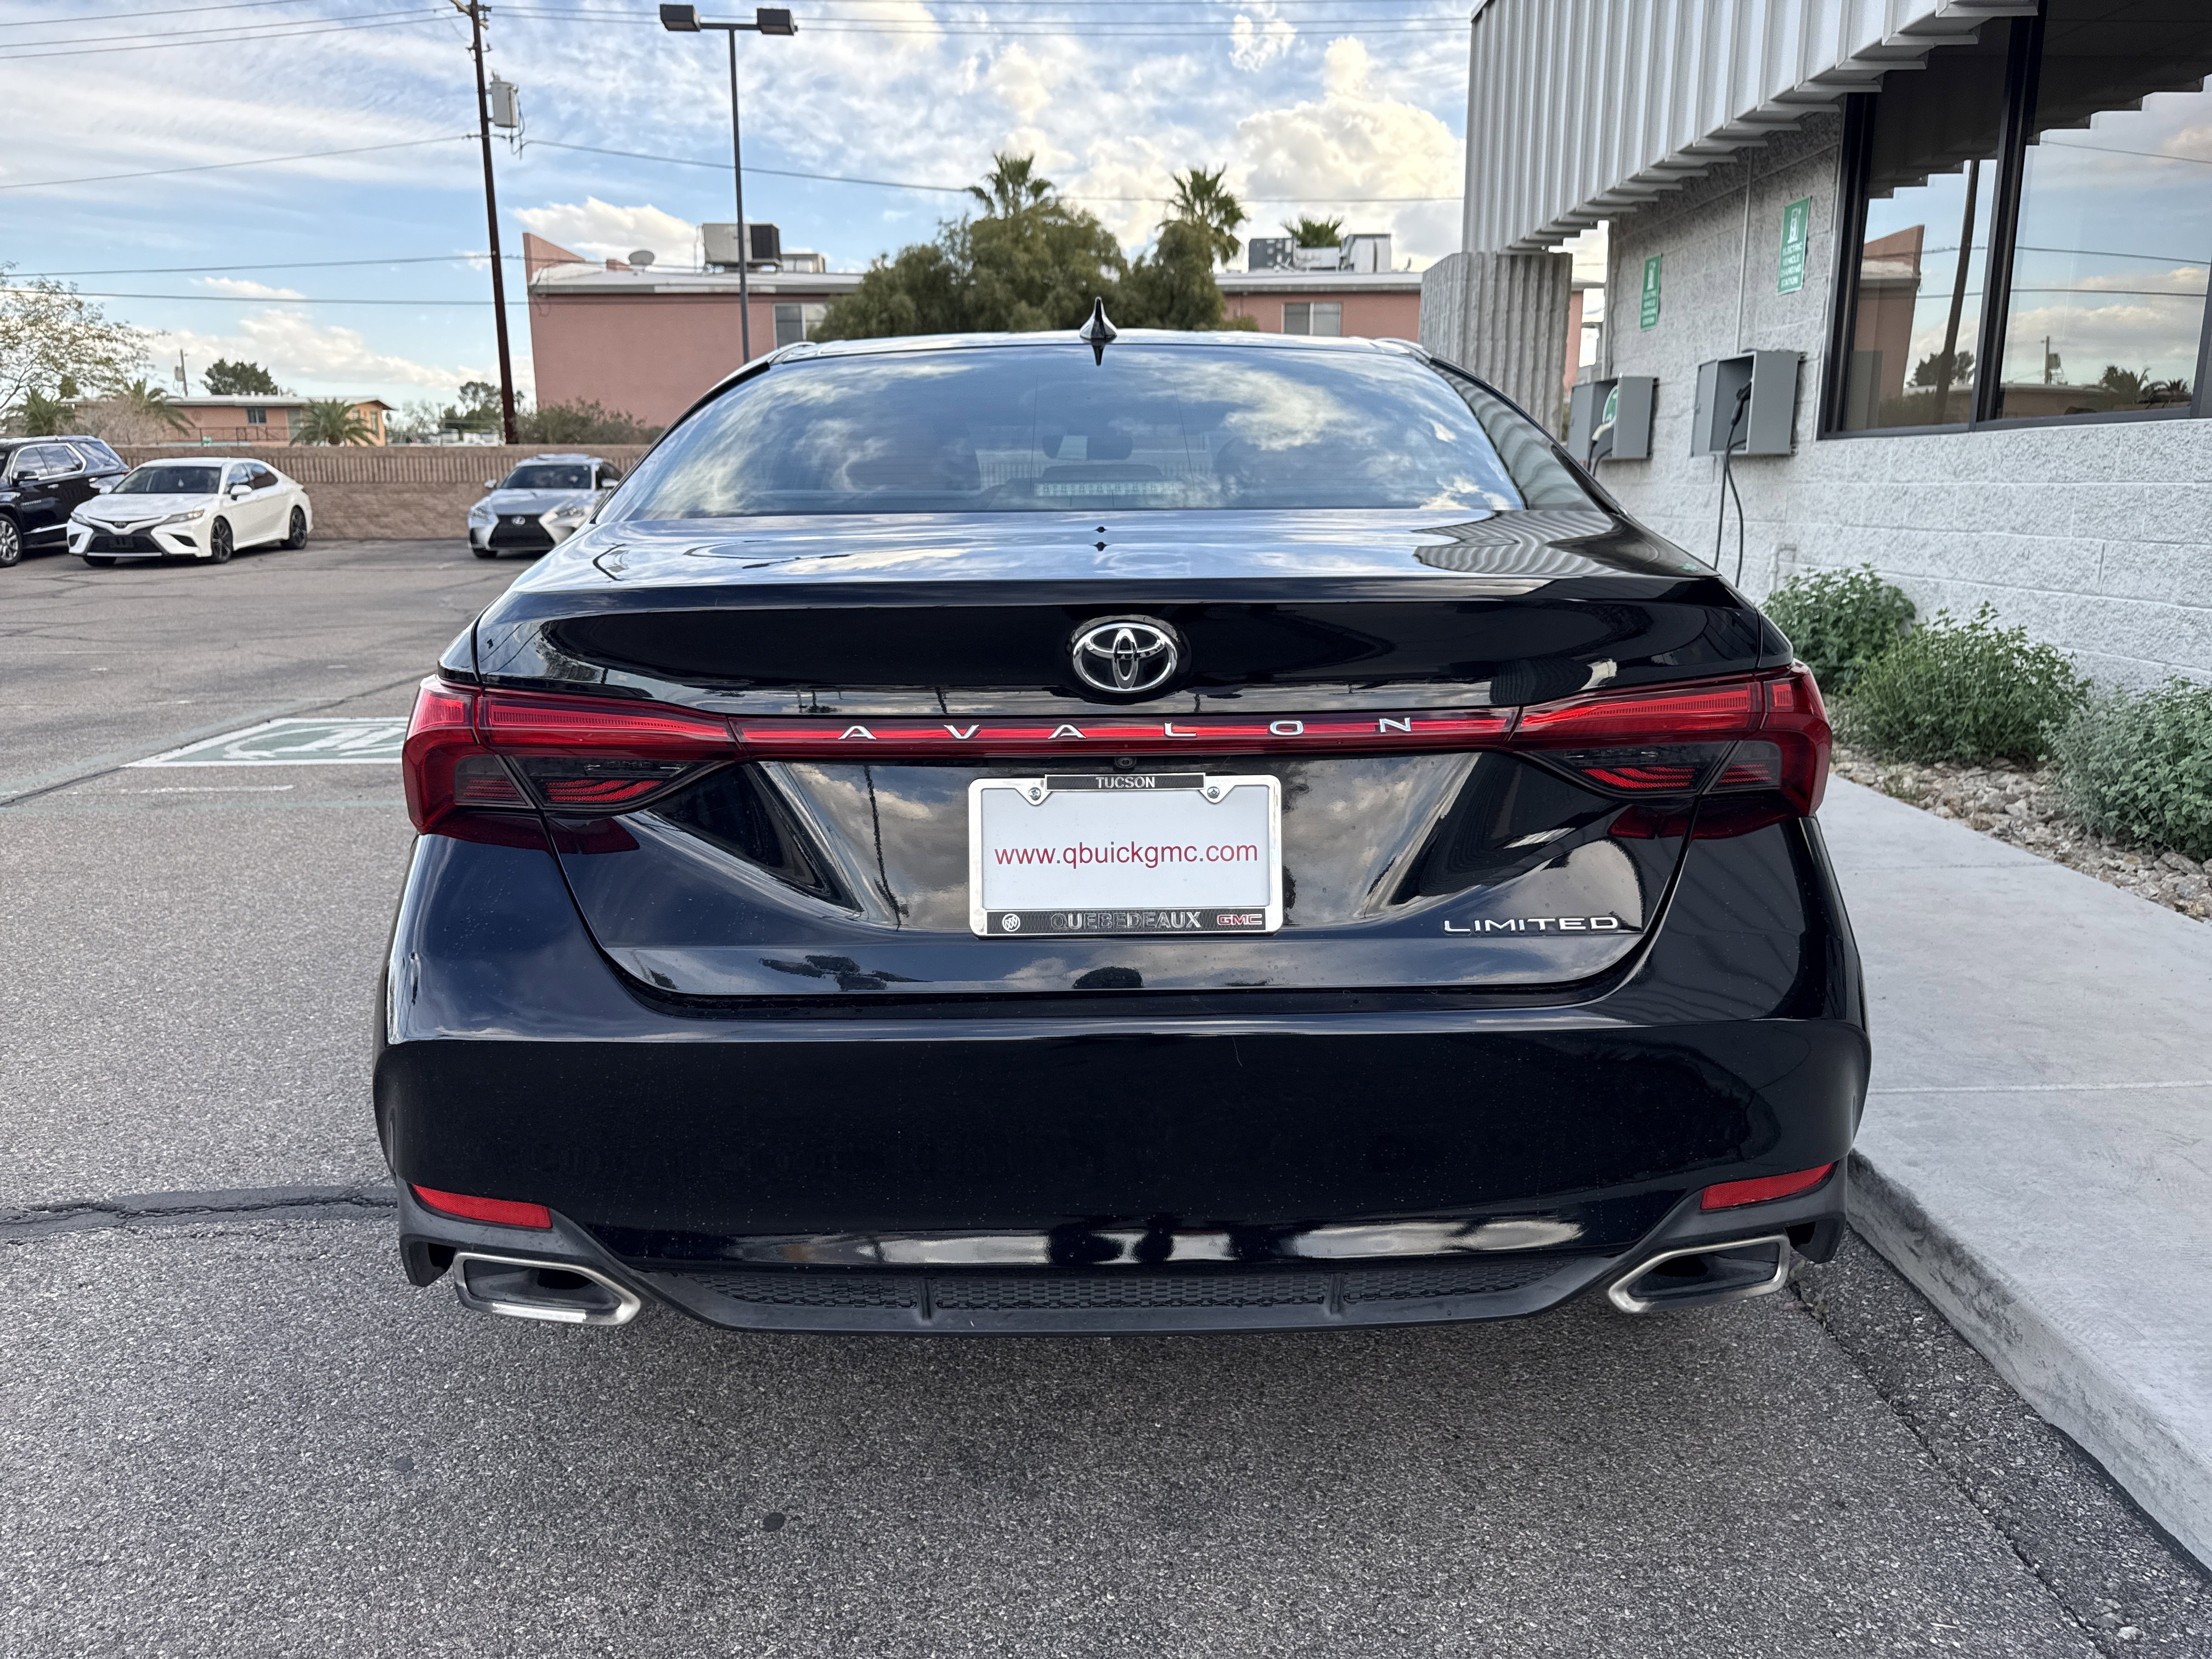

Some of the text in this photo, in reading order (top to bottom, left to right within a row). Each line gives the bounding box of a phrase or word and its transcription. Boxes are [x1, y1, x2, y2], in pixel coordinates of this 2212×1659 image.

[838, 717, 1412, 741] AVALON
[1096, 776, 1155, 788] TUCSON
[995, 842, 1257, 869] www.qbuickgmc.com
[1051, 912, 1262, 930] QUEBEDEAUX GMC
[1444, 917, 1618, 932] LIMITED
